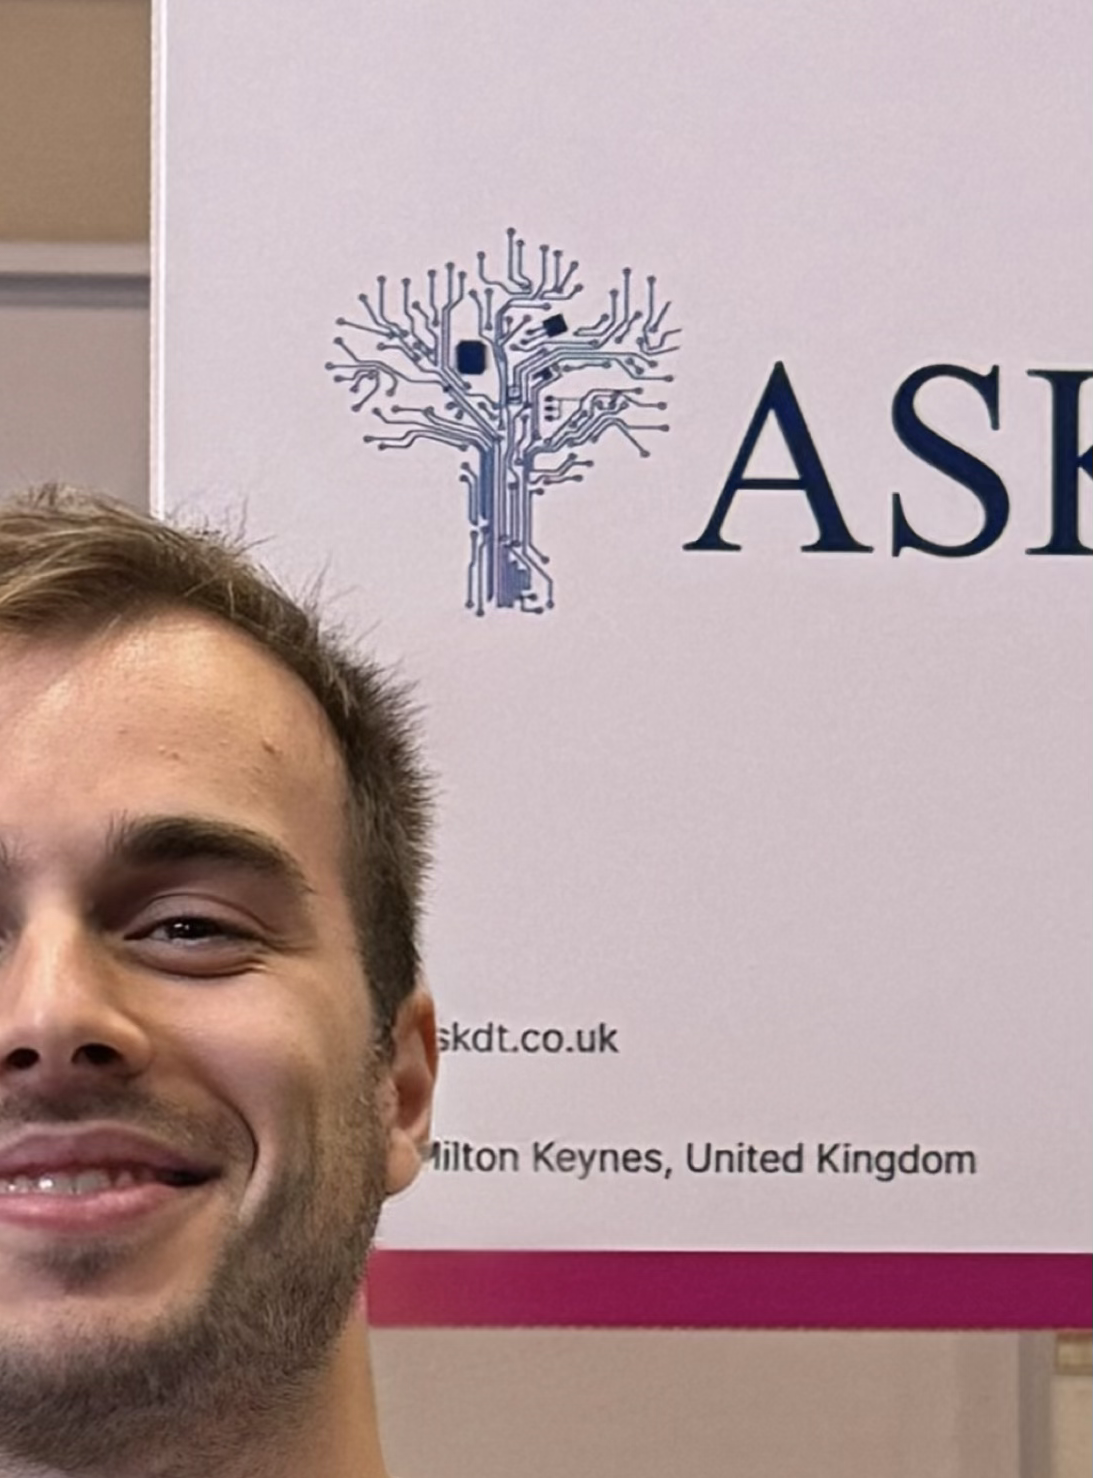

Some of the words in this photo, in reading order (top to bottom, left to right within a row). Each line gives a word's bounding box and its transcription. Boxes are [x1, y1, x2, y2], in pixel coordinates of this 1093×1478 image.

[532, 1141, 673, 1180] Keynes,
[686, 1142, 804, 1174] United
[816, 1143, 977, 1182] Kingdom
